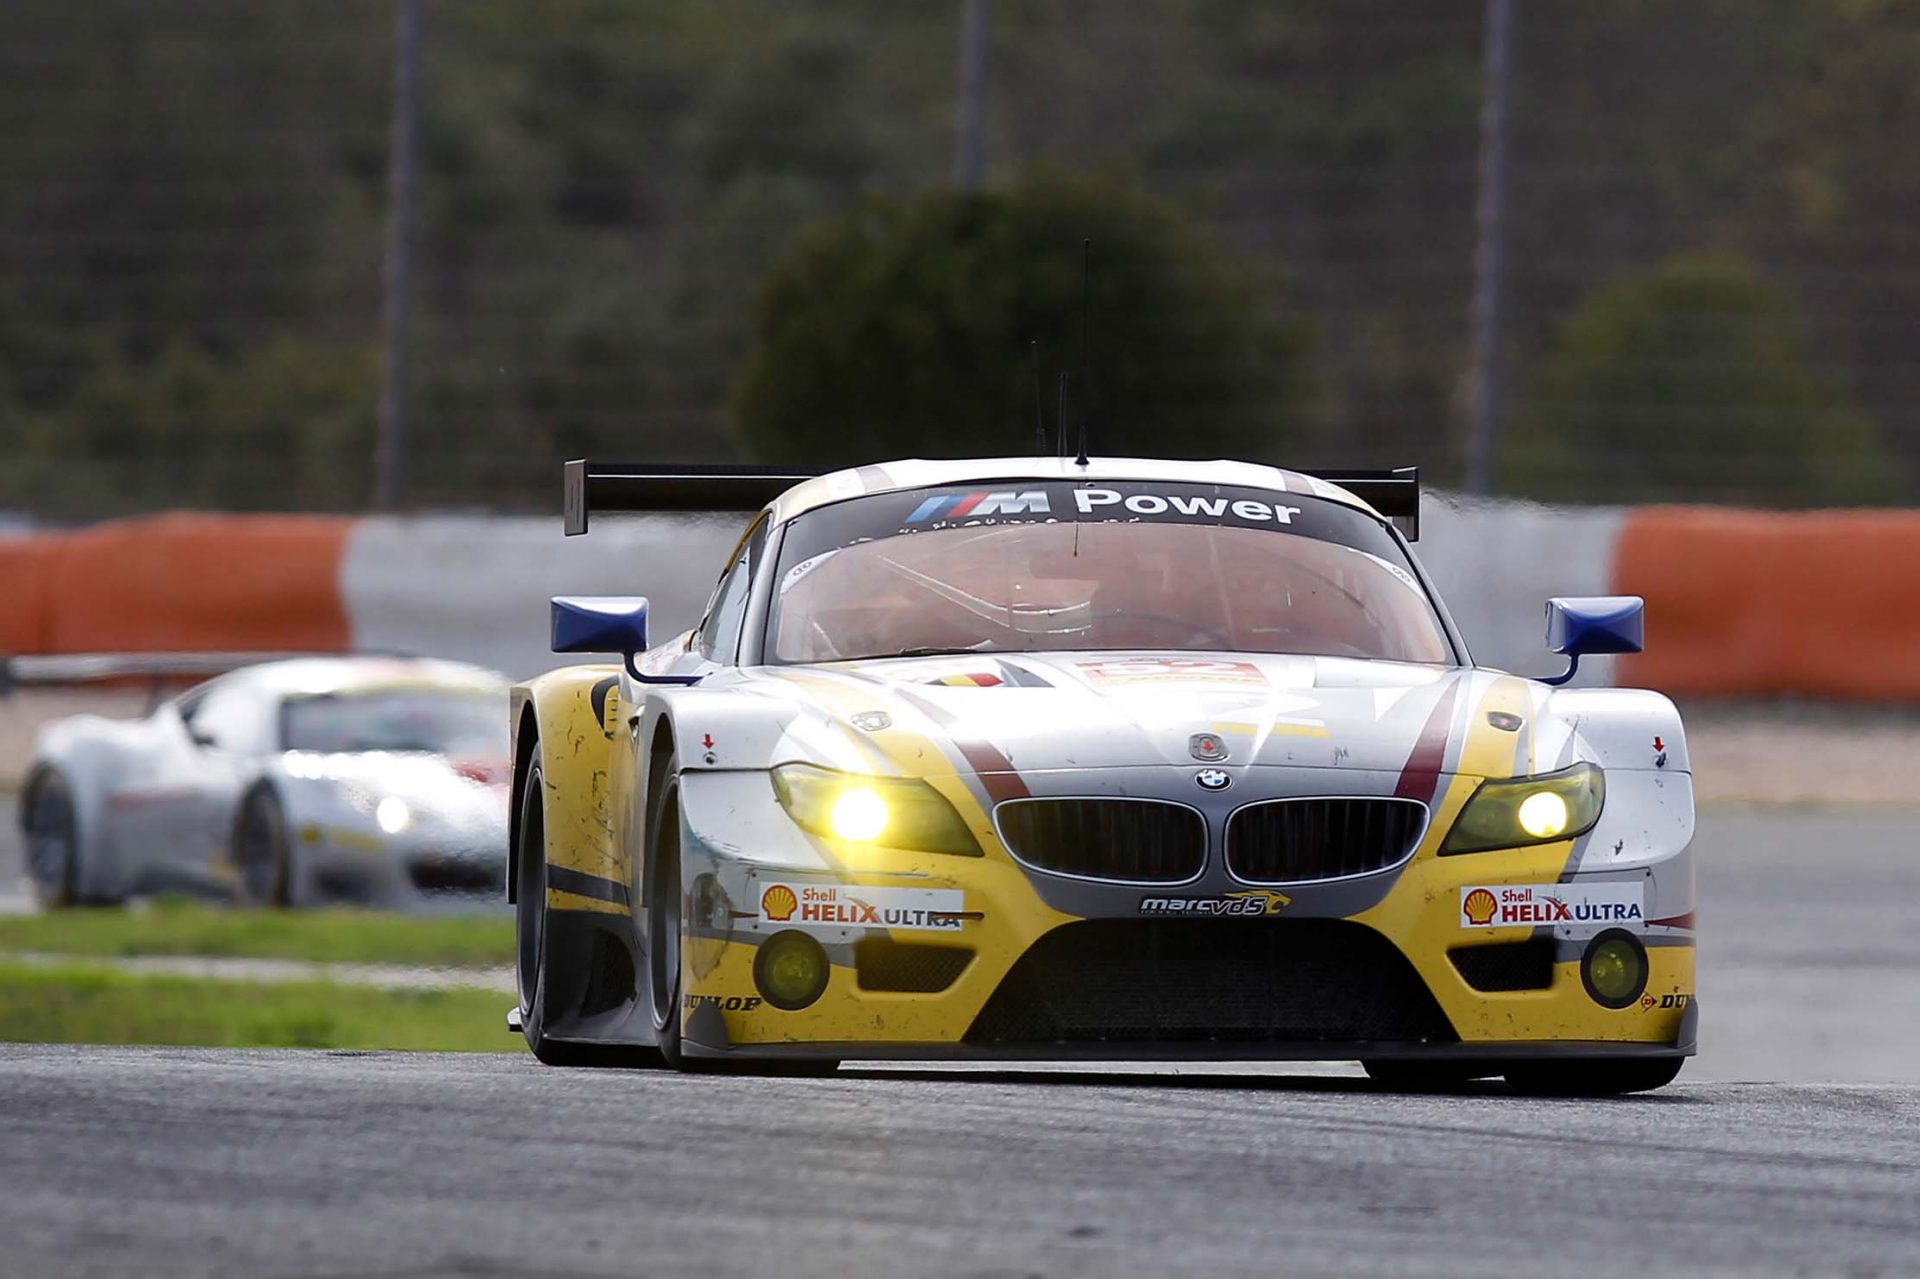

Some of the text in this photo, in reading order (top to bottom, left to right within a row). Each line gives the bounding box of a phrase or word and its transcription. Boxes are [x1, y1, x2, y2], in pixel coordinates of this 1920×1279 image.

[1074, 488, 1301, 524] Power
[802, 888, 836, 902] Shell
[1501, 888, 1532, 902] Shell
[802, 903, 961, 928] HELIX ULTRA
[1501, 902, 1642, 922] HELIX ULTRA
